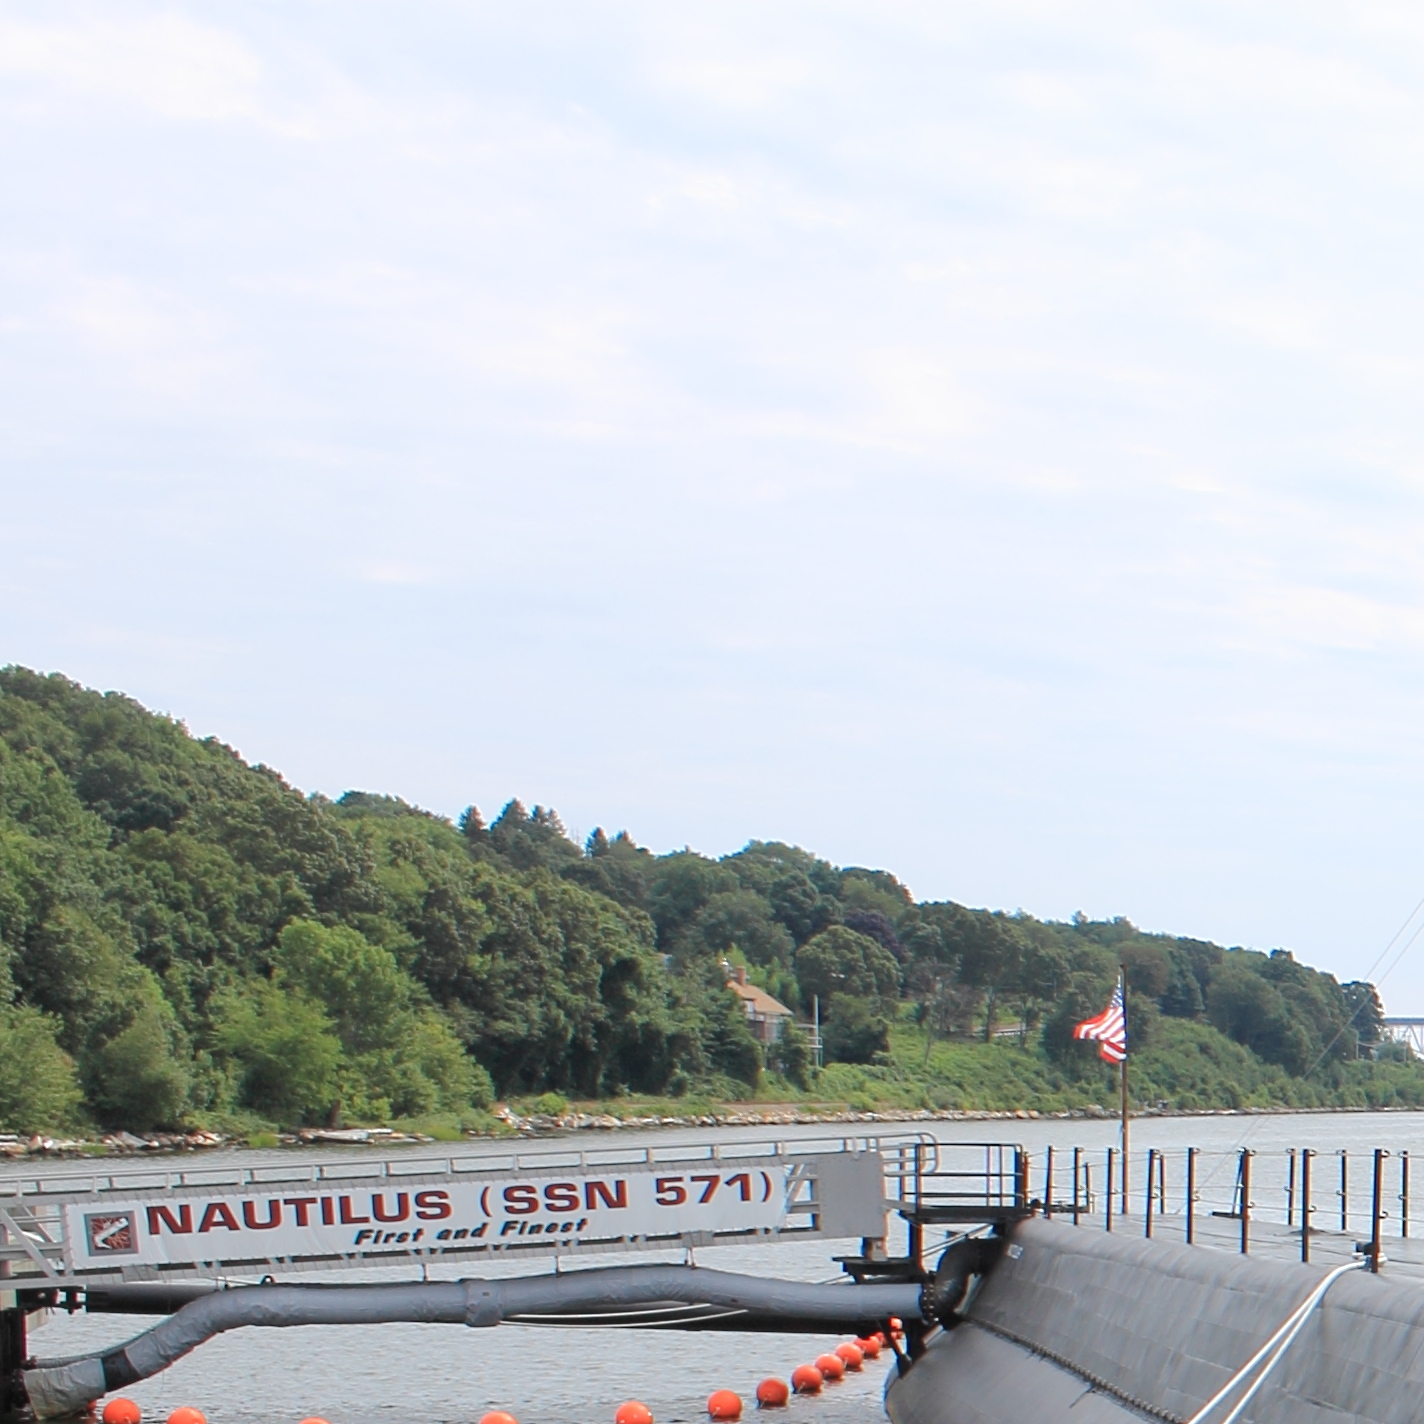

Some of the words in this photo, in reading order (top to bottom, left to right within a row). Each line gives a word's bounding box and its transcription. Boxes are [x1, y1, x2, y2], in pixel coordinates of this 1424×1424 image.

[146, 1190, 453, 1236] NAUTILUS
[480, 1179, 629, 1218] (SSN
[655, 1171, 773, 1206] 571)
[354, 1228, 425, 1245] First
[436, 1222, 490, 1240] and
[500, 1218, 589, 1236] Finest
